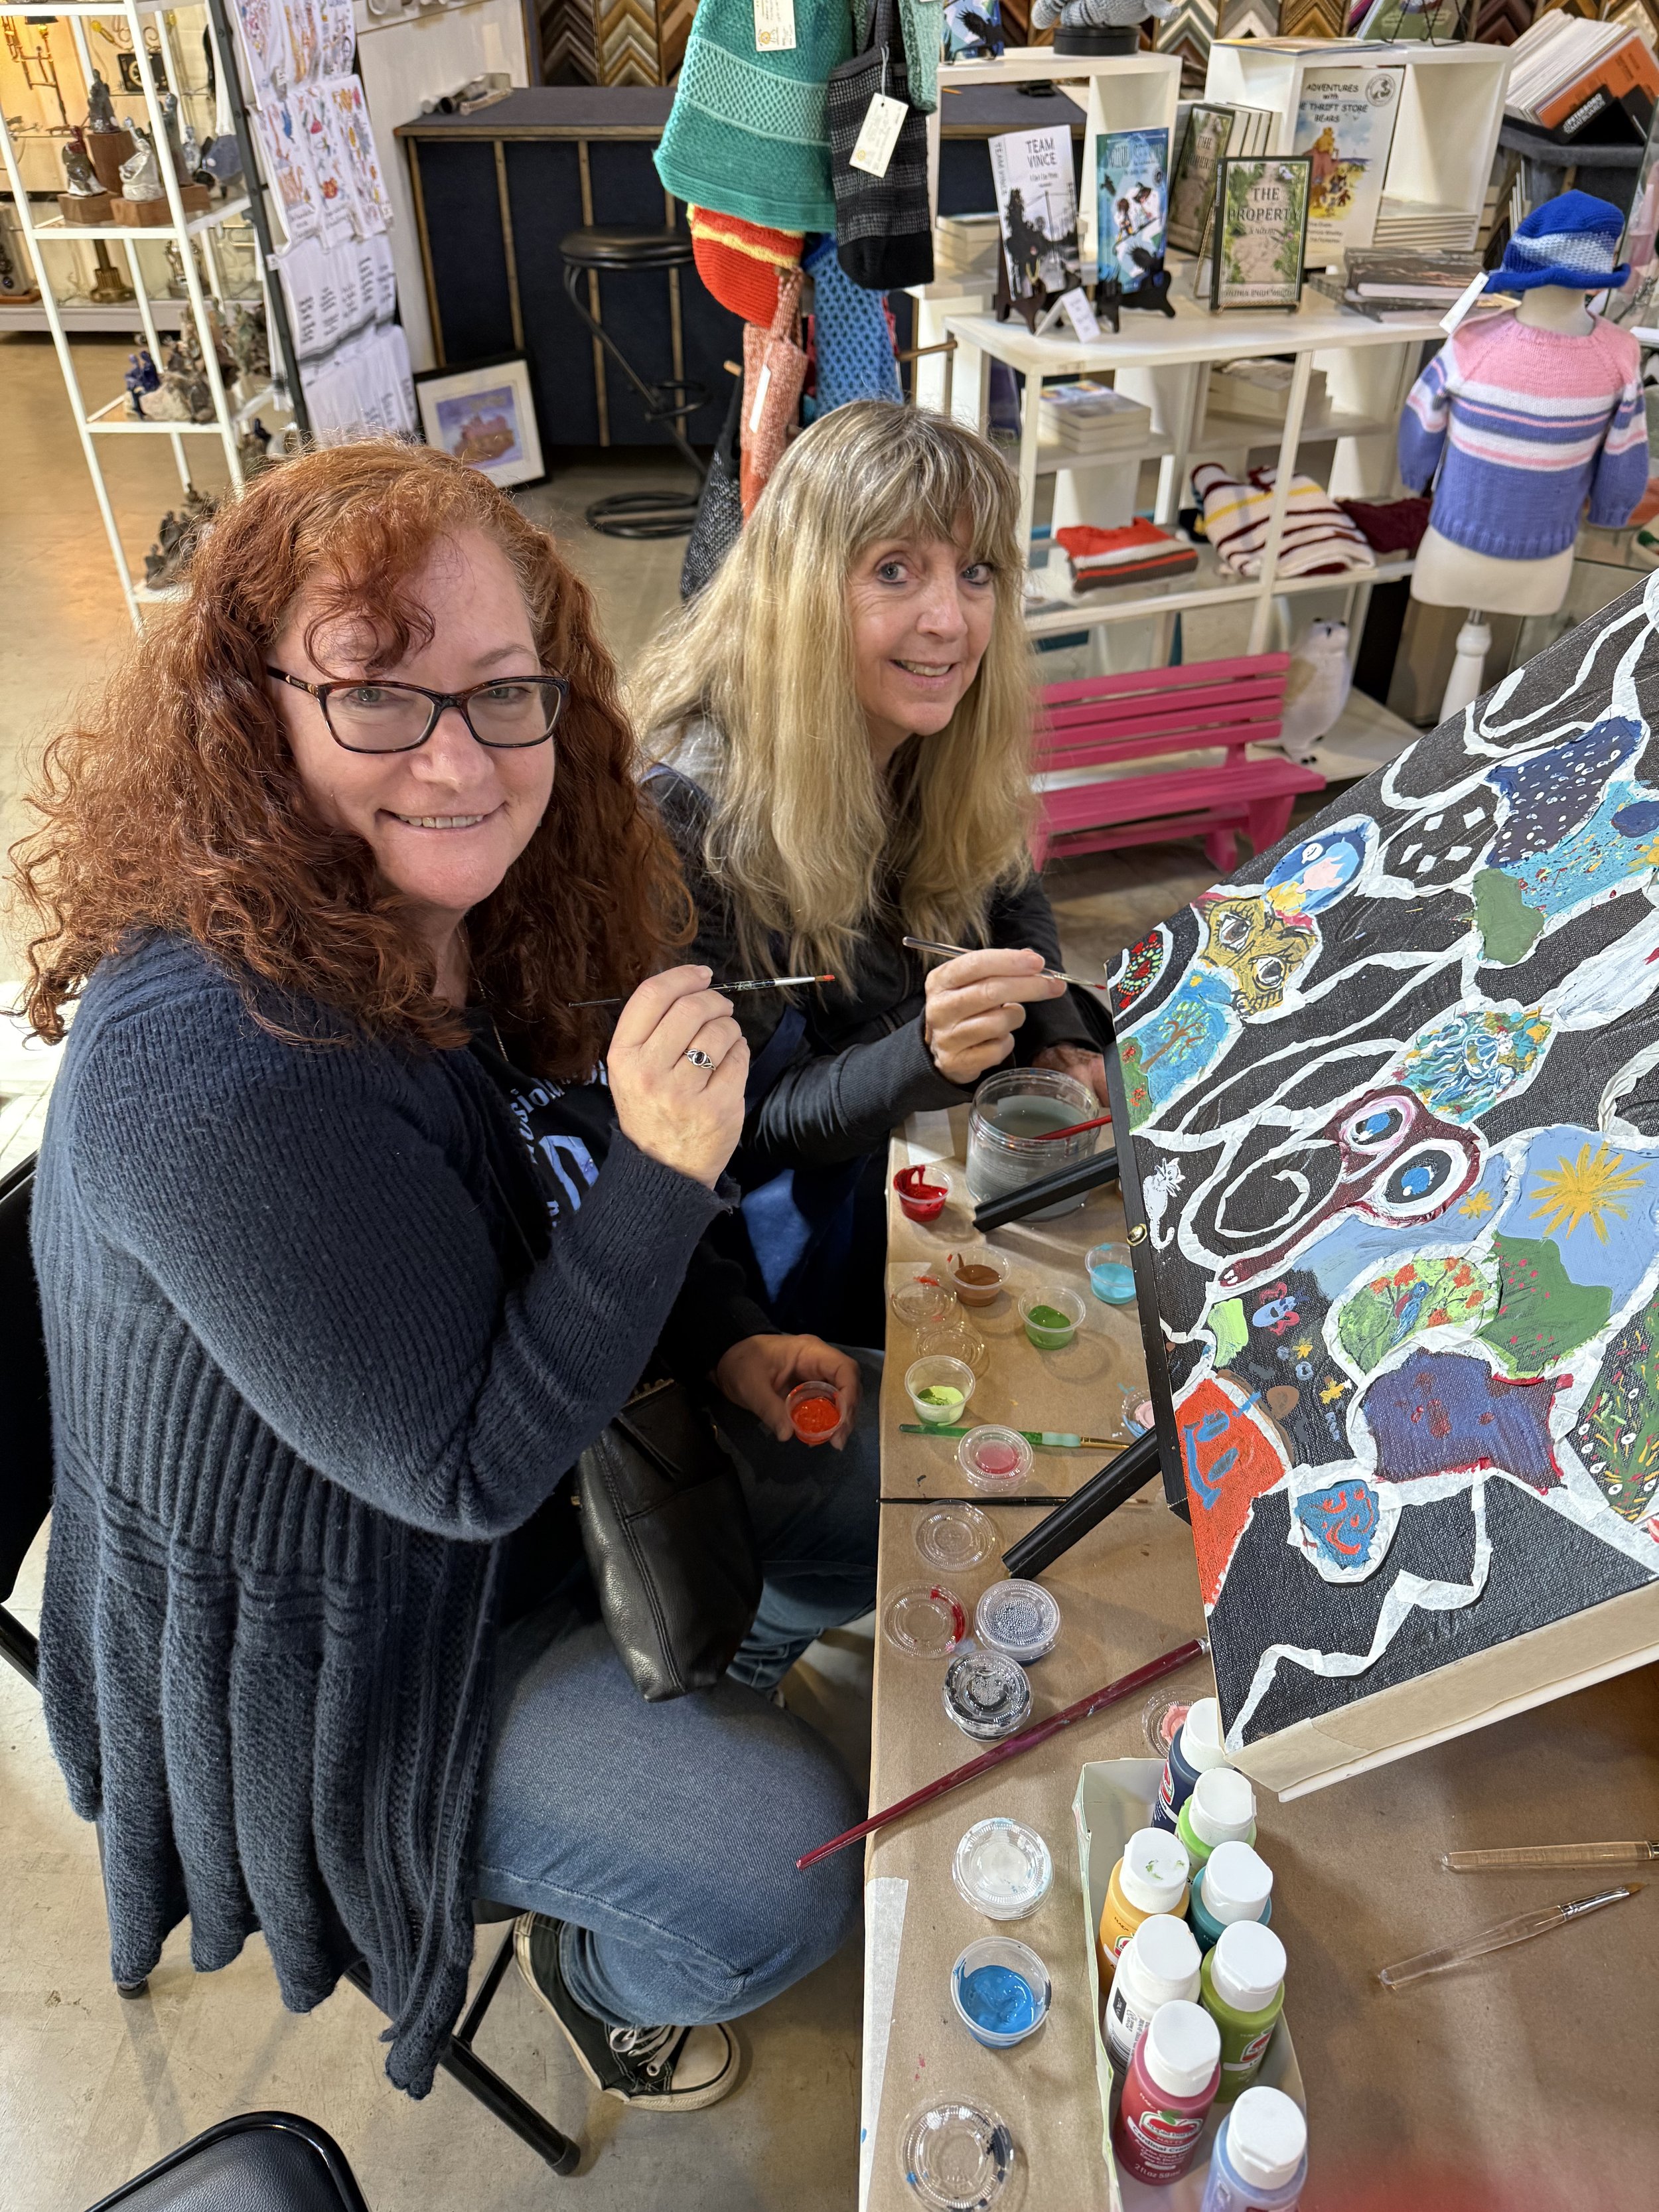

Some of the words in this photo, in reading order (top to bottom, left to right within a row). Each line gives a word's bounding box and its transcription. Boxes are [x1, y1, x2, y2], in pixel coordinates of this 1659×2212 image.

[1306, 83, 1359, 92] ADVENTURES
[1309, 102, 1339, 111] THRIFT
[1341, 104, 1369, 113] STORE
[1314, 113, 1340, 123] BEARS
[1025, 137, 1055, 154] TEAM
[1028, 152, 1058, 168] VINCE
[1252, 186, 1280, 201] THE
[1229, 207, 1303, 221] PROPERTY
[1132, 2126, 1167, 2152] Cardinal
